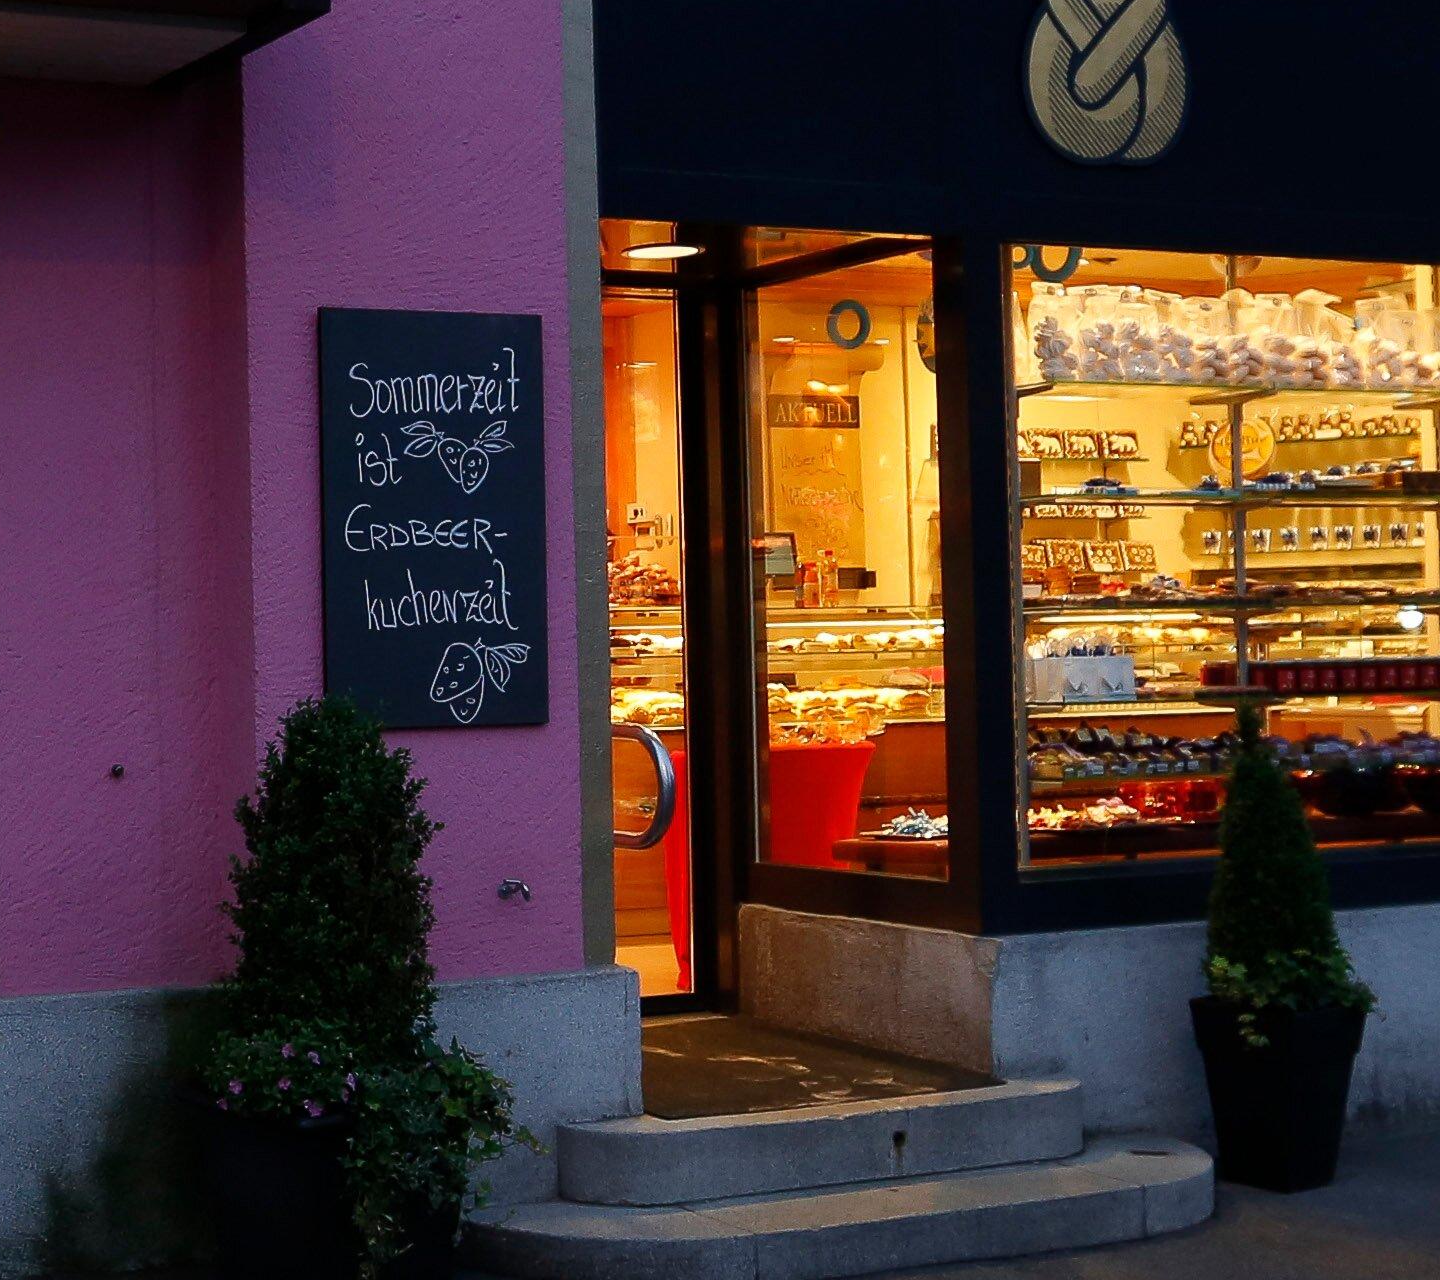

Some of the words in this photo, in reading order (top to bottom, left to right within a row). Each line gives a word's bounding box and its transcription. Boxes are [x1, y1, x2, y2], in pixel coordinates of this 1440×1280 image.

[348, 347, 520, 418] Sommerzeit
[775, 402, 858, 423] AKTUELL
[355, 432, 403, 486] ist
